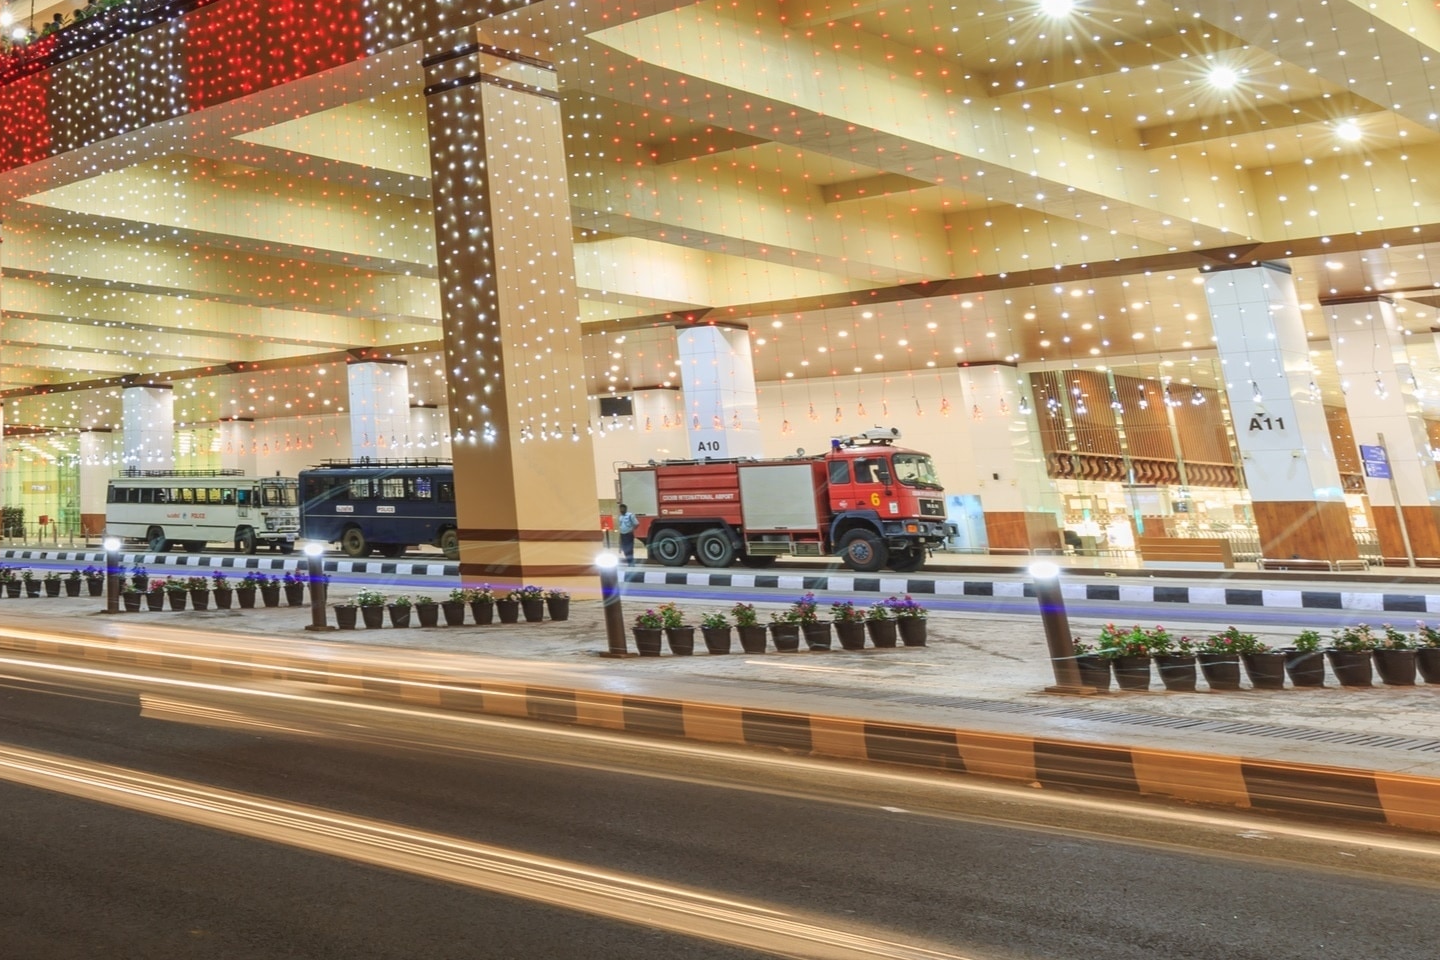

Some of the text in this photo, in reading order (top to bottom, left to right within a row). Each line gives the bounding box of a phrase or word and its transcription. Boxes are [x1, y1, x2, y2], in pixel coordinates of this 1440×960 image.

[1249, 416, 1285, 431] A11
[697, 440, 720, 452] A10
[870, 492, 881, 507] 6
